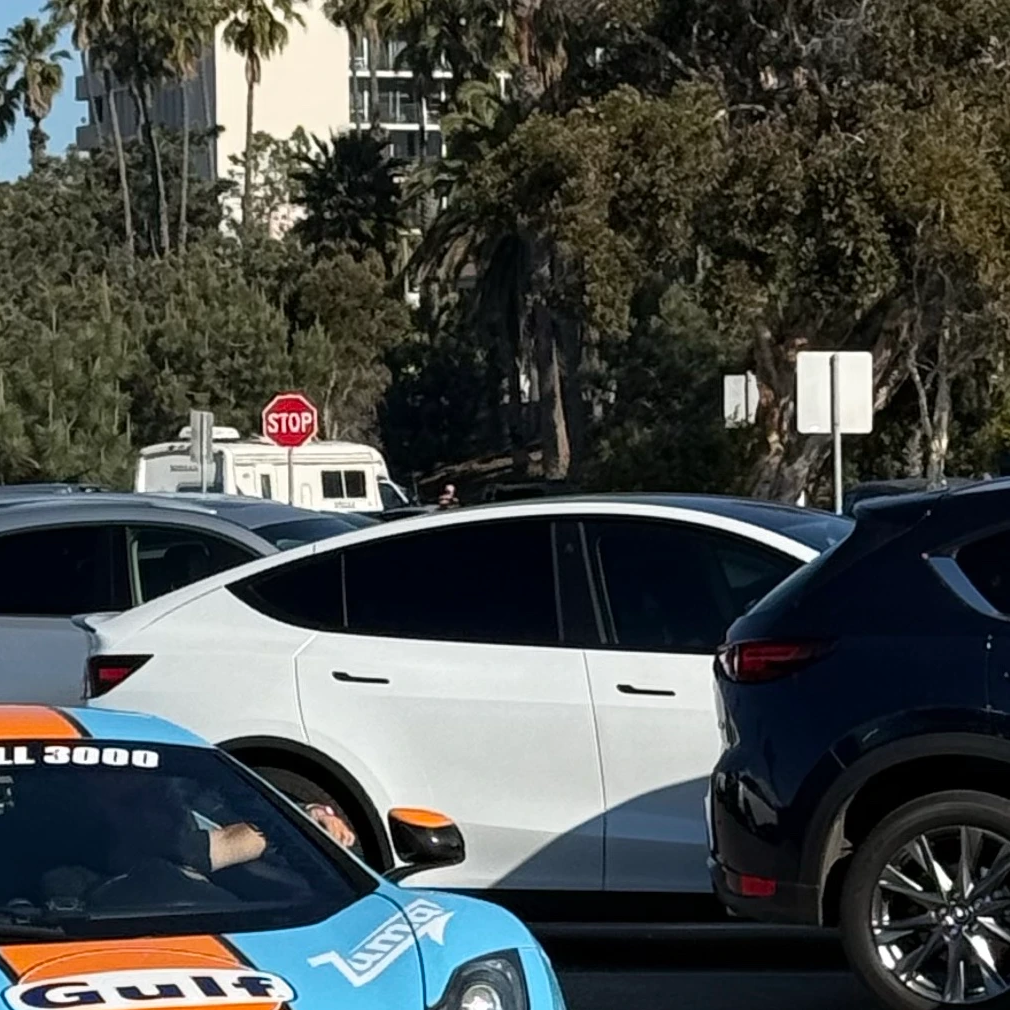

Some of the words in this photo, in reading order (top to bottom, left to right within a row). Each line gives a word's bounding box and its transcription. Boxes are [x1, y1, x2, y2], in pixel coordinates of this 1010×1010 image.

[267, 411, 313, 434] STOP
[43, 746, 160, 768] 3000
[19, 975, 275, 1009] Gulf
